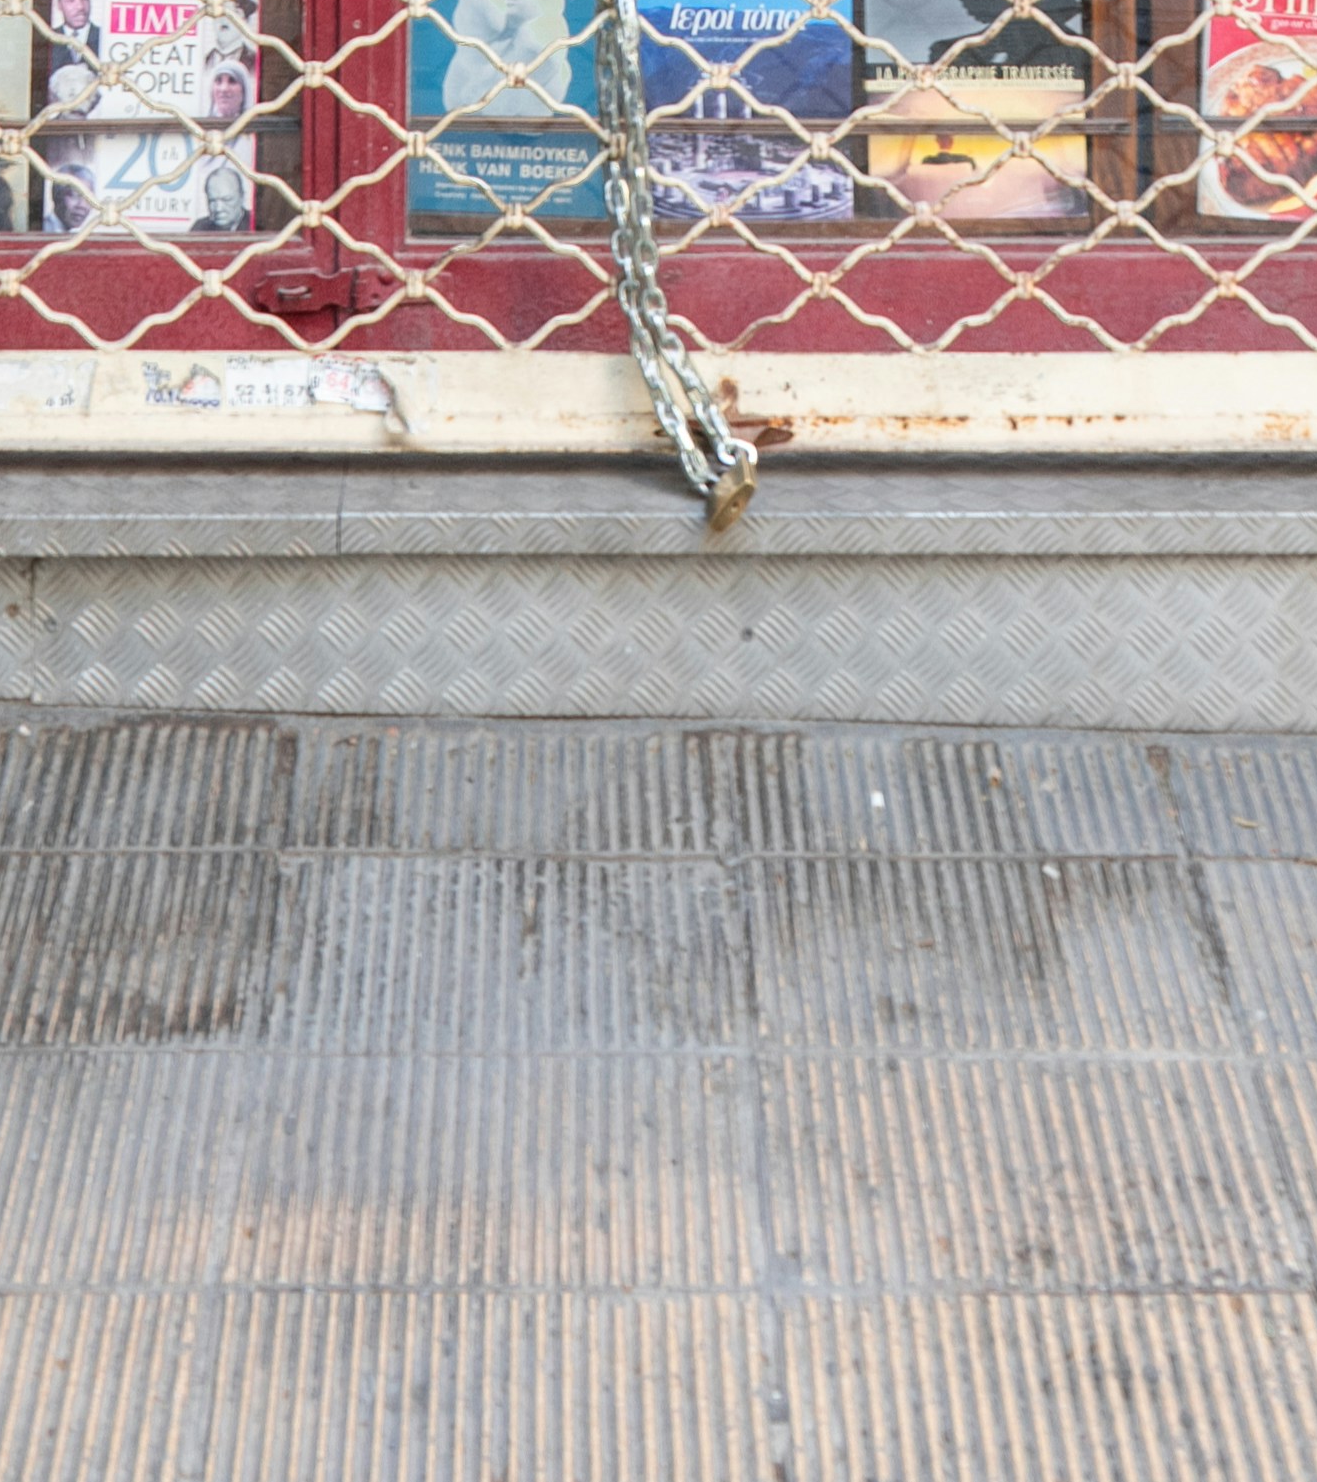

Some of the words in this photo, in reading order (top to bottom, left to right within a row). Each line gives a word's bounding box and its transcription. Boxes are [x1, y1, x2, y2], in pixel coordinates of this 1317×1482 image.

[113, 3, 199, 35] TIME
[108, 41, 196, 66] GREAT
[475, 162, 512, 177] VAN
